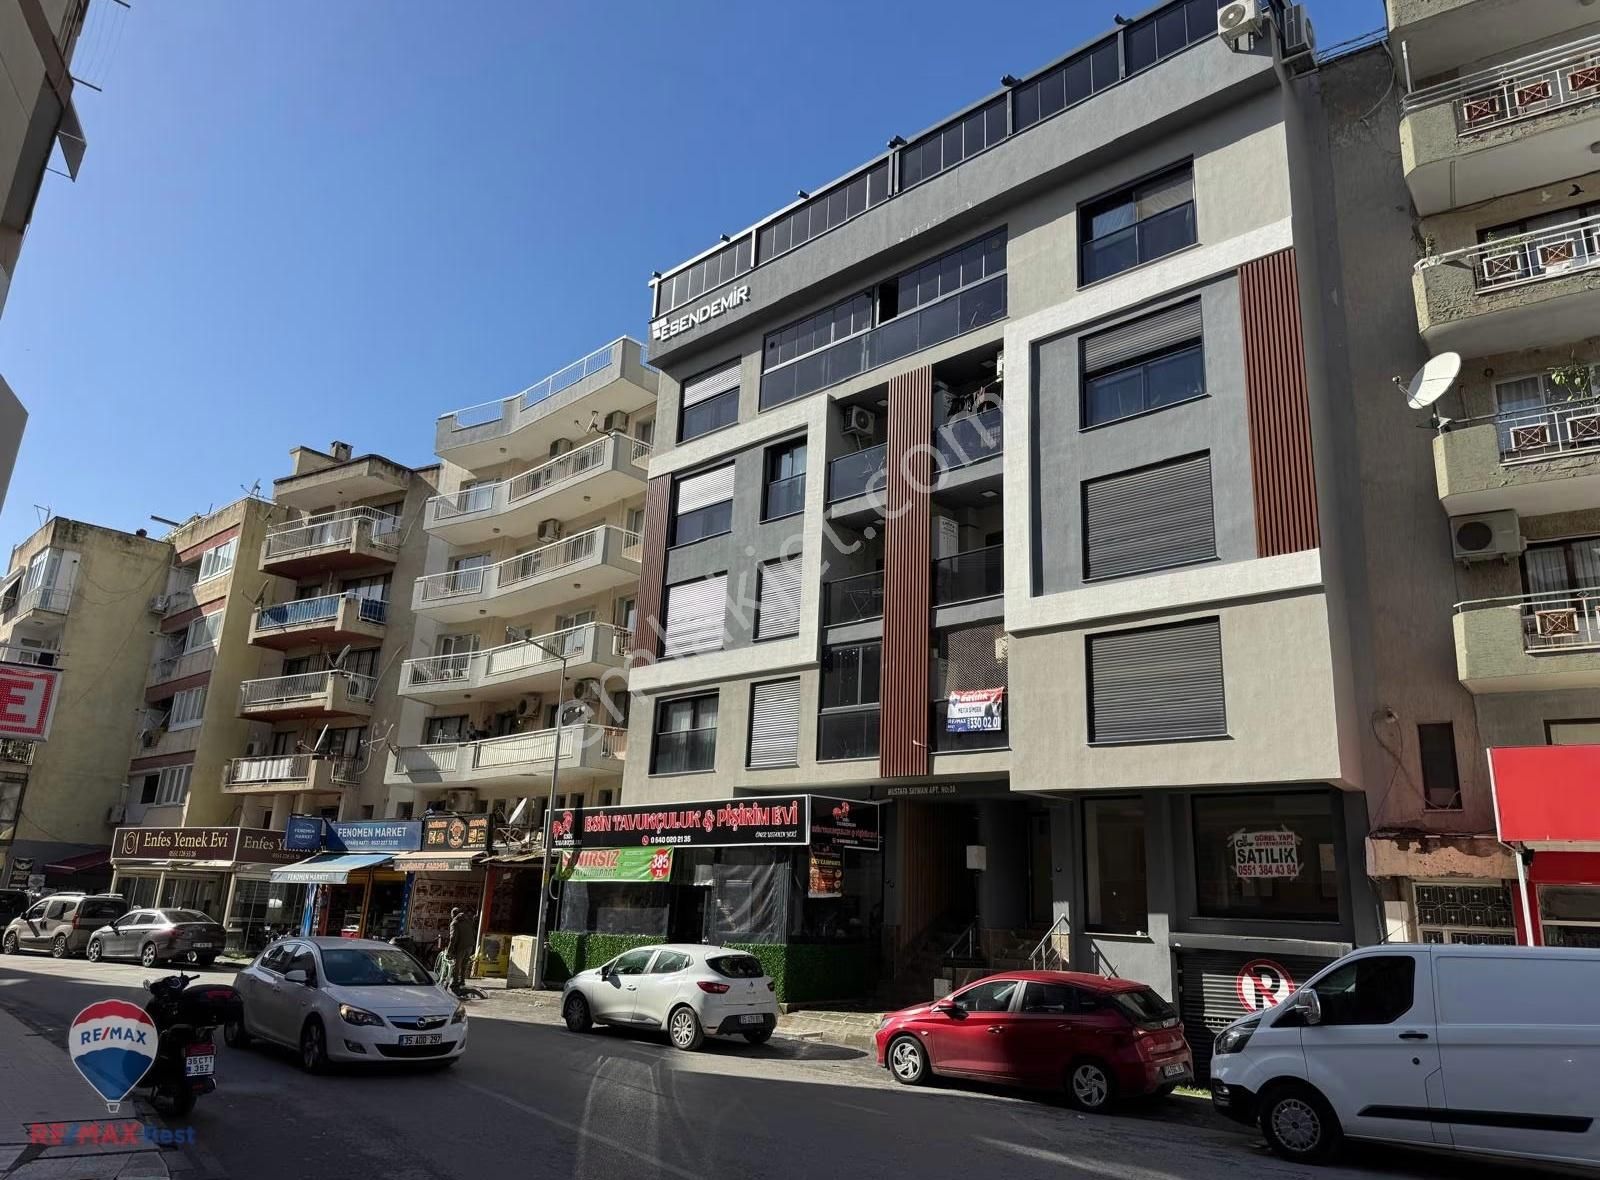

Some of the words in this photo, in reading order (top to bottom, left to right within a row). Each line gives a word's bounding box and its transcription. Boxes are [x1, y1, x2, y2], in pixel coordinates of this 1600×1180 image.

[983, 716, 992, 728] 02
[612, 810, 701, 834] TAVUKÇULUK
[717, 802, 770, 832] PİŞİRİM
[143, 832, 172, 848] Enfes
[173, 830, 207, 848] Yemek
[209, 832, 229, 848] Evi
[337, 828, 373, 838] FENOMEN
[374, 827, 407, 837] MARKET
[243, 835, 274, 850] Enfes
[1237, 847, 1296, 864] SATILIK
